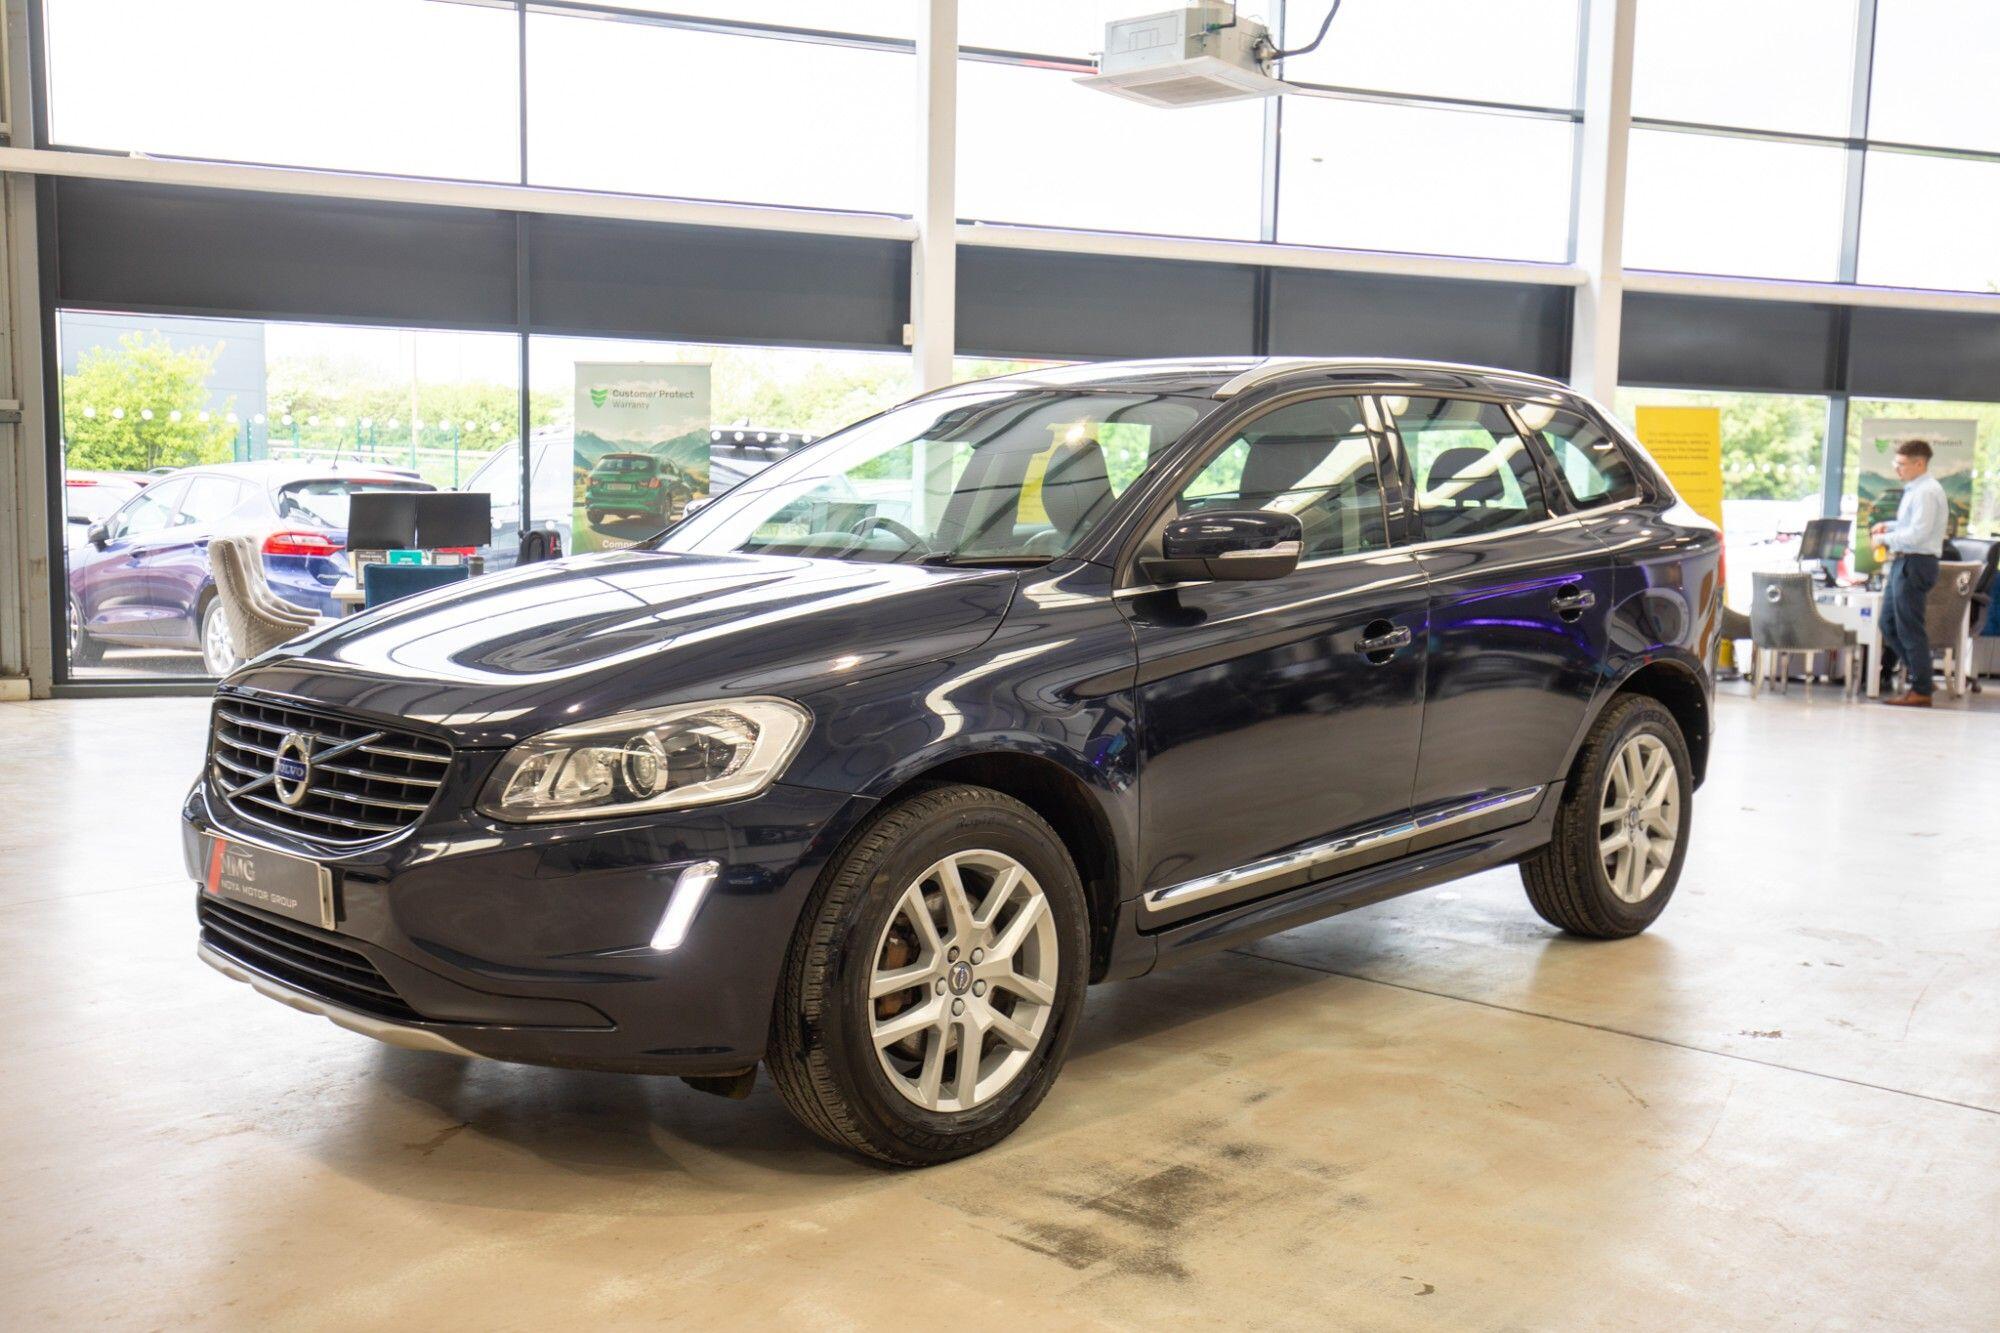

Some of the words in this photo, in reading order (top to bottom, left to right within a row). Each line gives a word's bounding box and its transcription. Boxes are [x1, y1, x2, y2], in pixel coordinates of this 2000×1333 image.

[612, 389, 656, 399] Customer
[659, 390, 695, 399] Protect
[612, 400, 650, 410] Warranty
[275, 761, 305, 778] OLVO
[242, 885, 269, 900] MOTOR
[270, 893, 298, 909] GROUP
